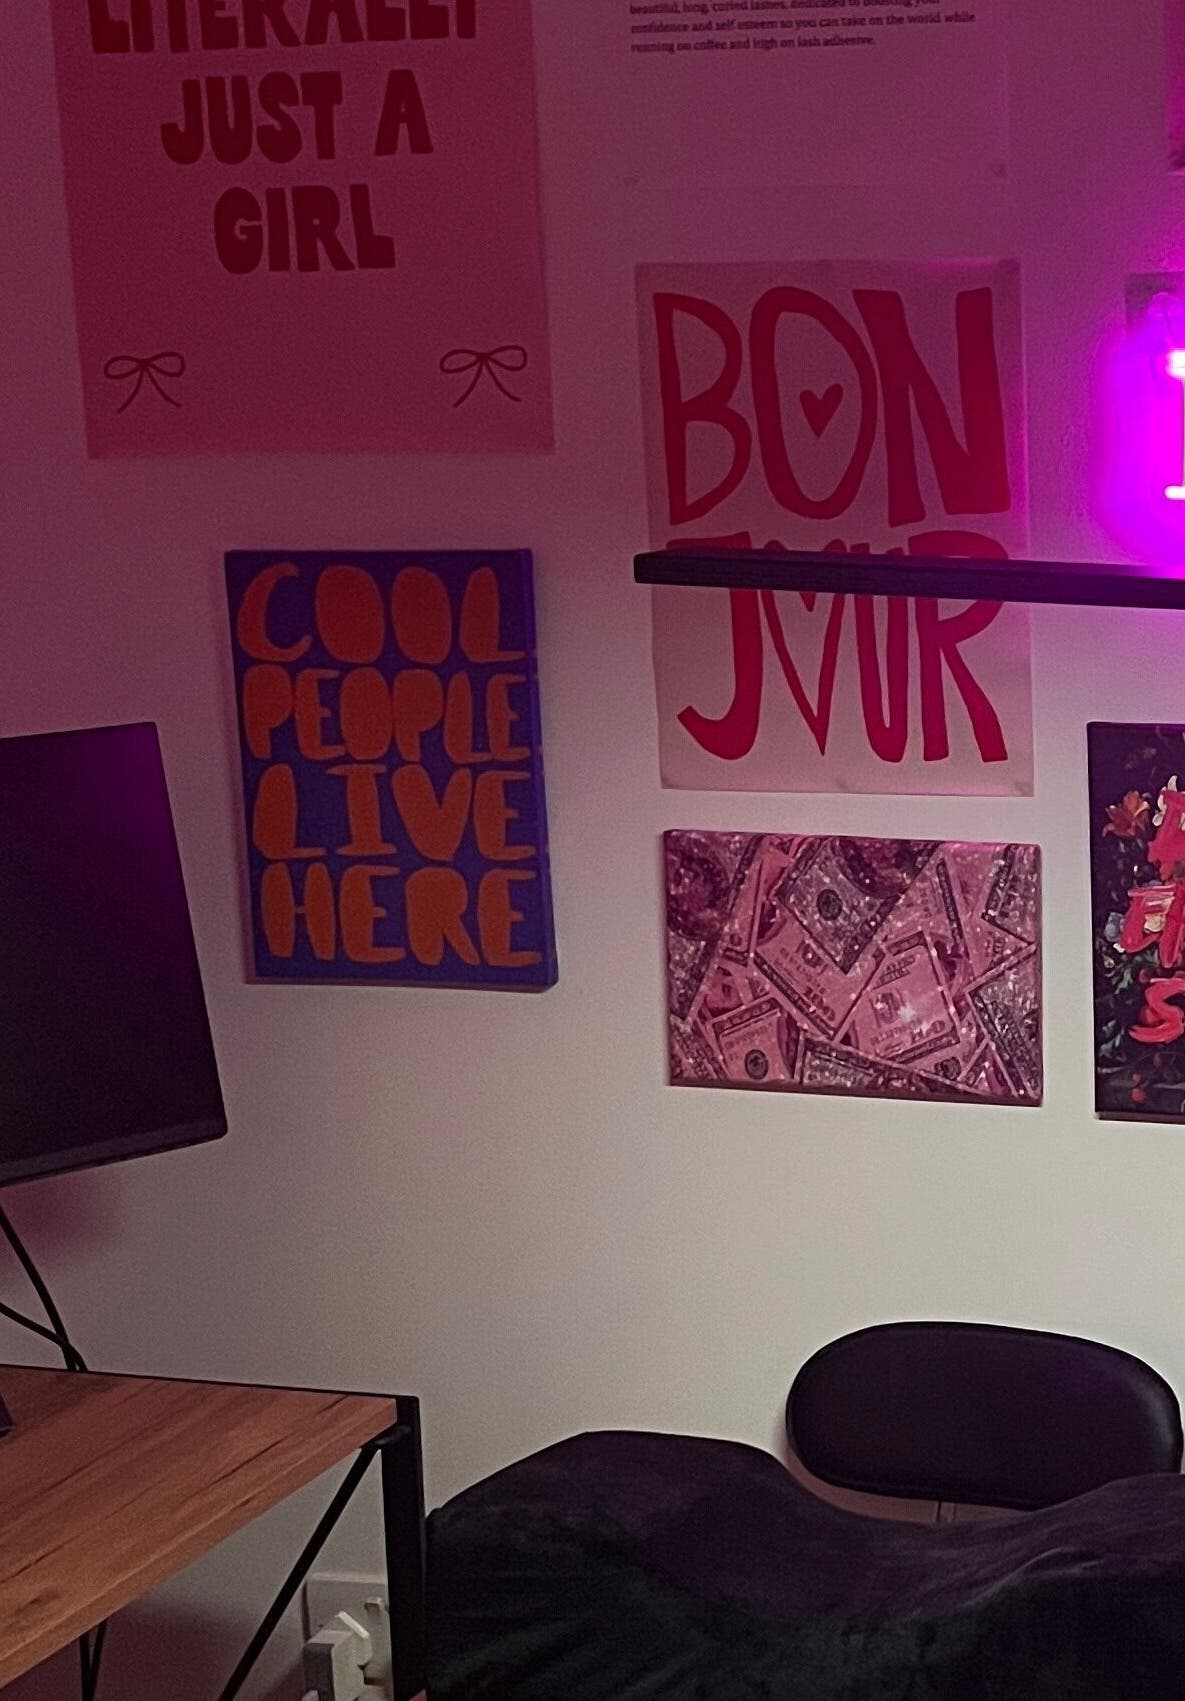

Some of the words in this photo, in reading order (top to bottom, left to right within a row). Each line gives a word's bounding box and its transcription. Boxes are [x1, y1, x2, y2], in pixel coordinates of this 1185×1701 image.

[631, 20, 689, 33] confidence
[692, 20, 712, 32] and
[715, 19, 735, 31] self
[795, 20, 817, 31] you
[820, 18, 839, 27] can
[842, 17, 865, 27] take
[869, 18, 883, 26] on
[886, 13, 904, 25] the
[907, 12, 940, 24] world
[944, 10, 975, 23] while
[693, 40, 727, 51] coffee
[730, 38, 749, 50] and
[753, 38, 777, 52] high
[160, 71, 343, 164] JUST
[374, 69, 434, 156] A
[213, 184, 397, 274] GIRL
[653, 286, 1011, 527] BON
[237, 562, 526, 664] COOL
[243, 664, 532, 764] PEOPLE
[252, 763, 537, 861] LIVE
[260, 861, 543, 967] HERE
